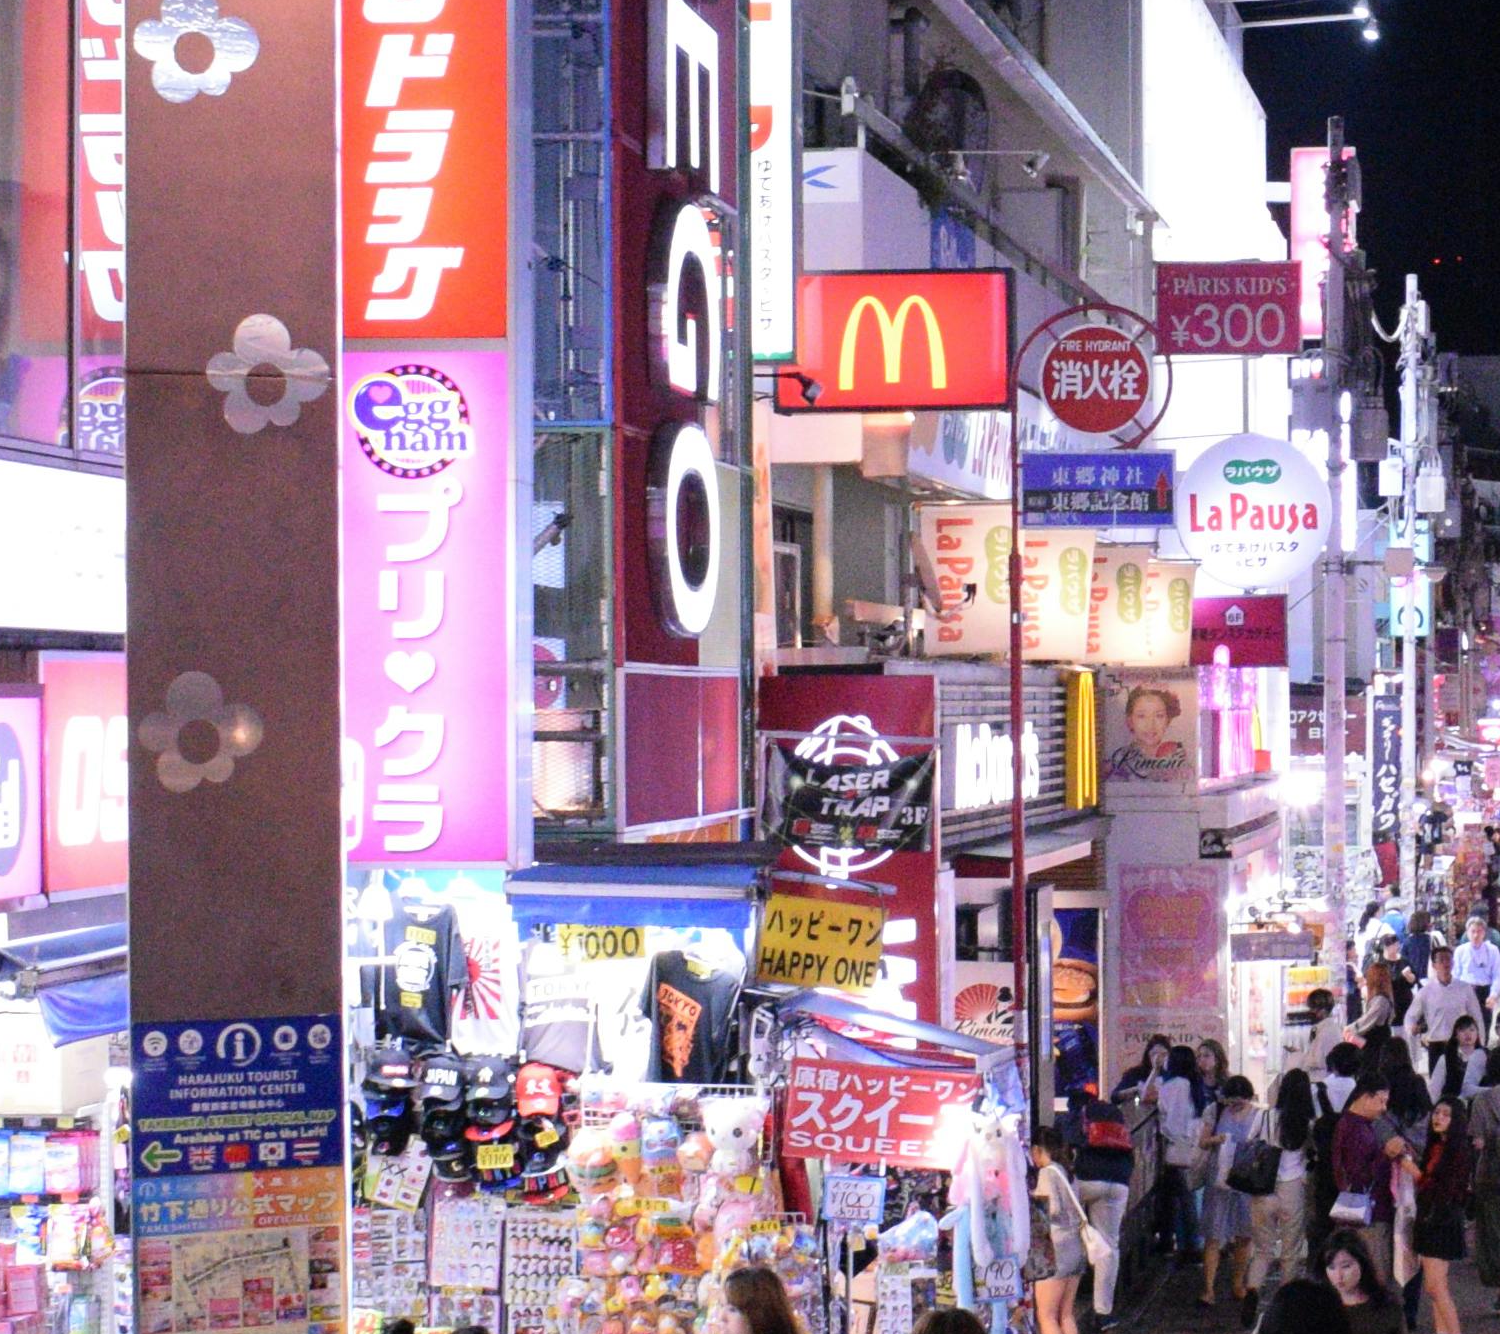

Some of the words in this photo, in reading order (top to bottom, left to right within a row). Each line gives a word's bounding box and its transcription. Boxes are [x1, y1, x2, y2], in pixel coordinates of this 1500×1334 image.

[1173, 275, 1230, 295] PARIS
[1235, 276, 1287, 296] KID'S
[1170, 302, 1286, 348] ¥300
[1060, 340, 1082, 352] FIRE
[1085, 340, 1132, 352] HYDRANT
[1051, 359, 1141, 401] 消火栓
[353, 378, 453, 432] egg
[382, 422, 470, 454] nam
[1053, 465, 1145, 486] 東郷神社
[1052, 491, 1150, 512] 東郷記念館
[1190, 493, 1222, 532] La
[1230, 492, 1319, 535] Pausa
[936, 518, 974, 551] La
[806, 768, 891, 792] LASER
[820, 796, 891, 818] TRAP
[901, 806, 929, 825] 3F
[767, 909, 884, 948] ハッピーワン
[761, 947, 830, 982] HAPPY
[834, 957, 876, 988] ONE
[178, 1072, 244, 1086] HARAJUKU
[247, 1069, 298, 1082] TOURIST
[426, 1068, 458, 1086] JAPAN
[794, 1065, 978, 1102] 原宿ハッピーワン
[169, 1085, 257, 1099] INFORMATION
[260, 1083, 306, 1095] CENTER
[244, 1129, 261, 1141] TIC
[140, 1191, 338, 1223] 竹下通り公式マップ
